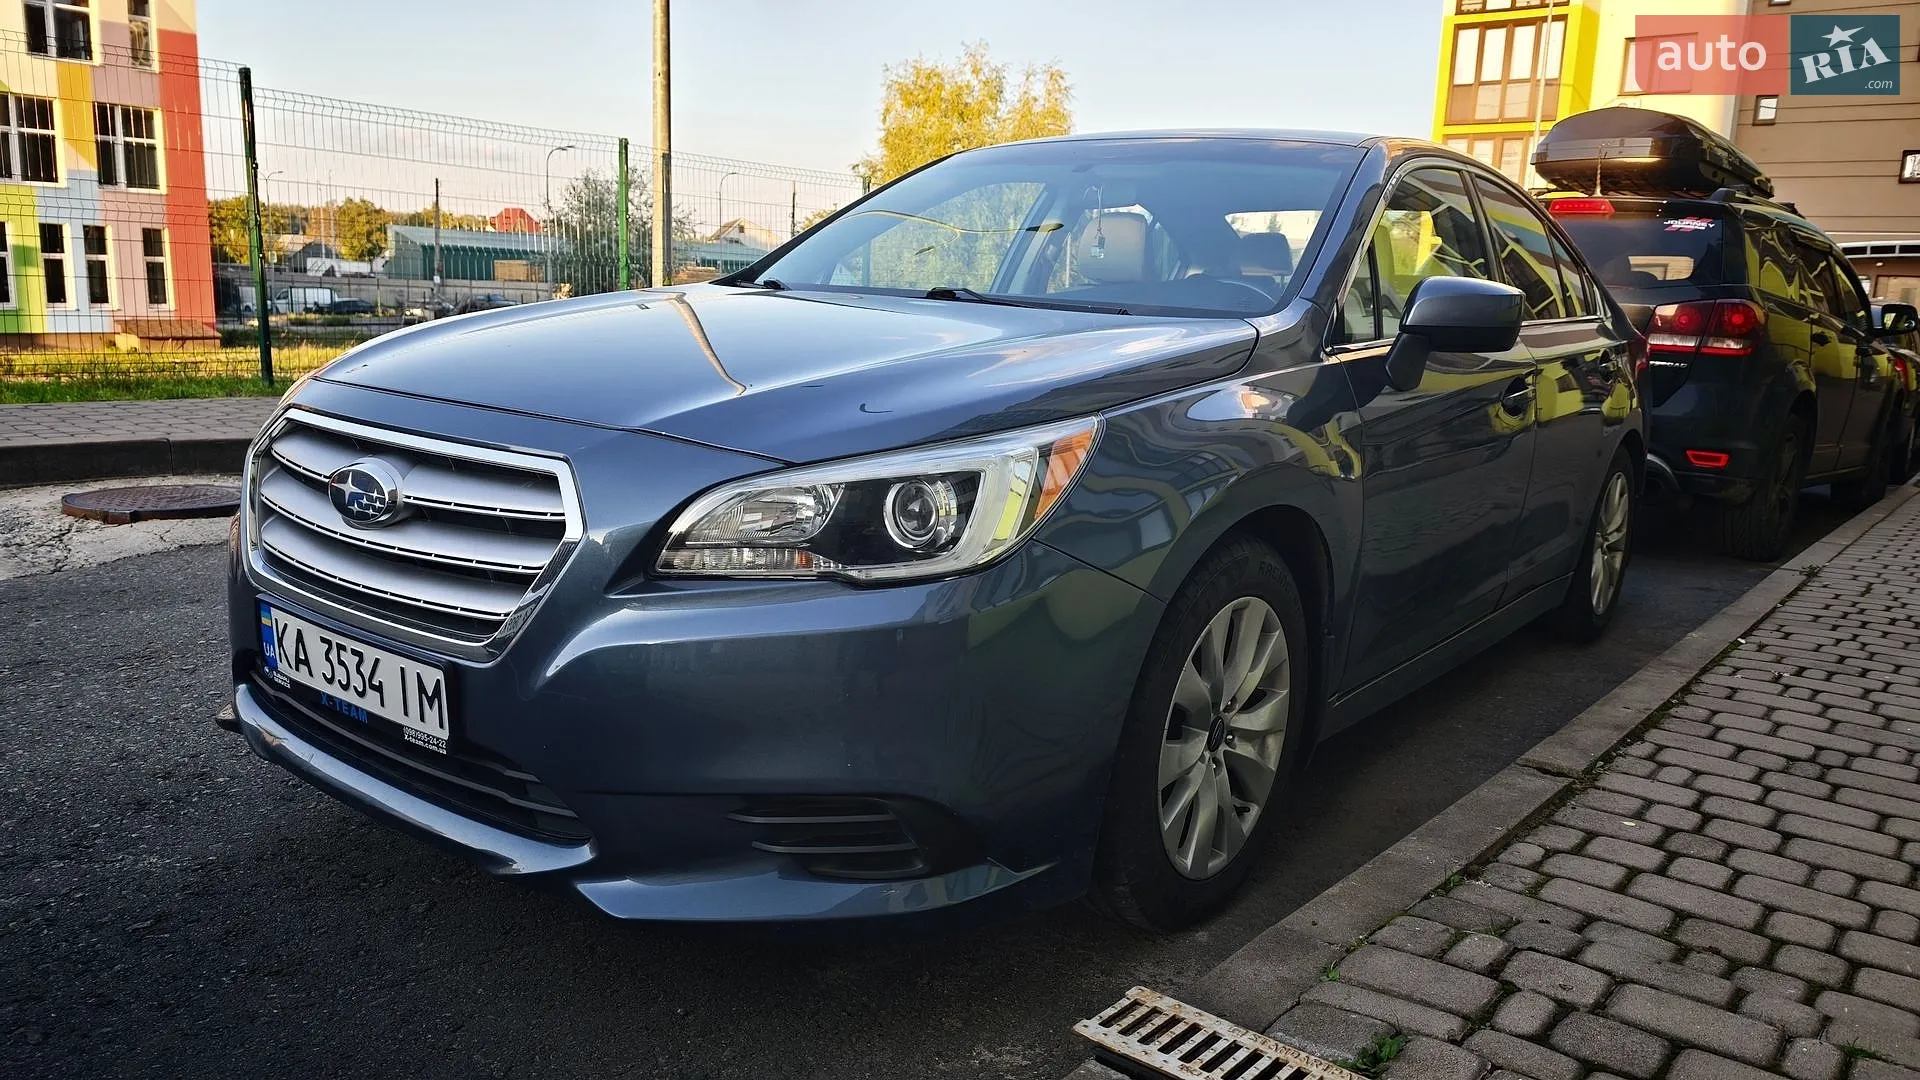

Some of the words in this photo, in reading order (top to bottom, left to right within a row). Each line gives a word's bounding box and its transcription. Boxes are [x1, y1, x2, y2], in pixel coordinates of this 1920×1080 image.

[1663, 218, 1715, 228] JOURNEY
[263, 641, 276, 660] UA
[274, 617, 314, 678] KA
[319, 635, 385, 708] 3534
[399, 666, 446, 730] IM
[320, 690, 368, 724] X-TEAM
